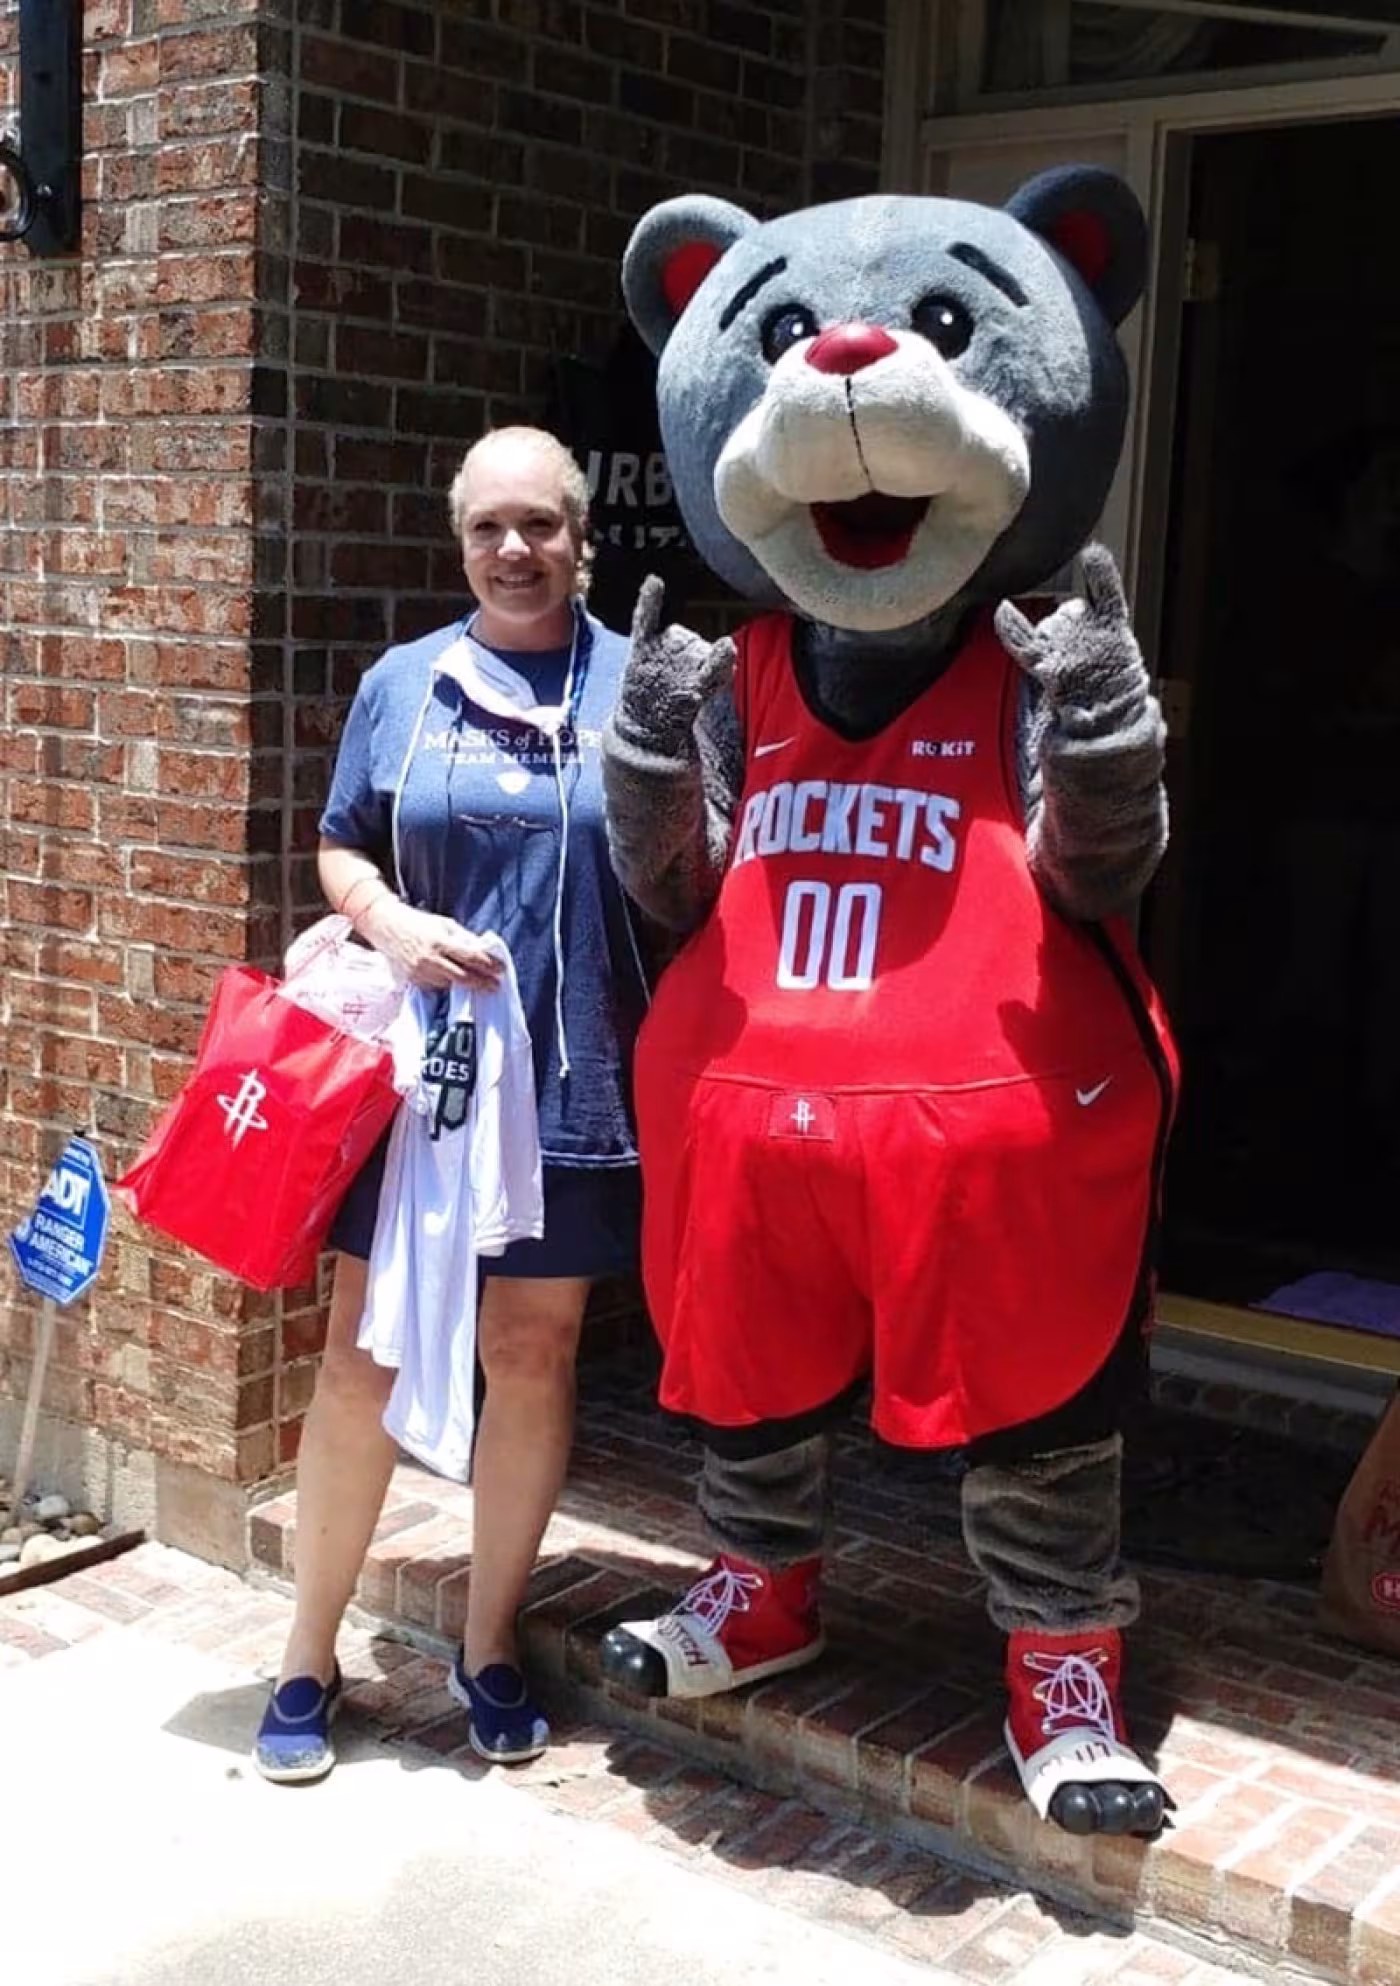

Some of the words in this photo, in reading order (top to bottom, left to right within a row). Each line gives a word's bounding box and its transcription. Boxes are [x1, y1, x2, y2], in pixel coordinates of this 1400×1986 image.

[732, 779, 961, 873] ROCKETS
[775, 880, 882, 991] 00
[40, 1166, 91, 1216] ADT
